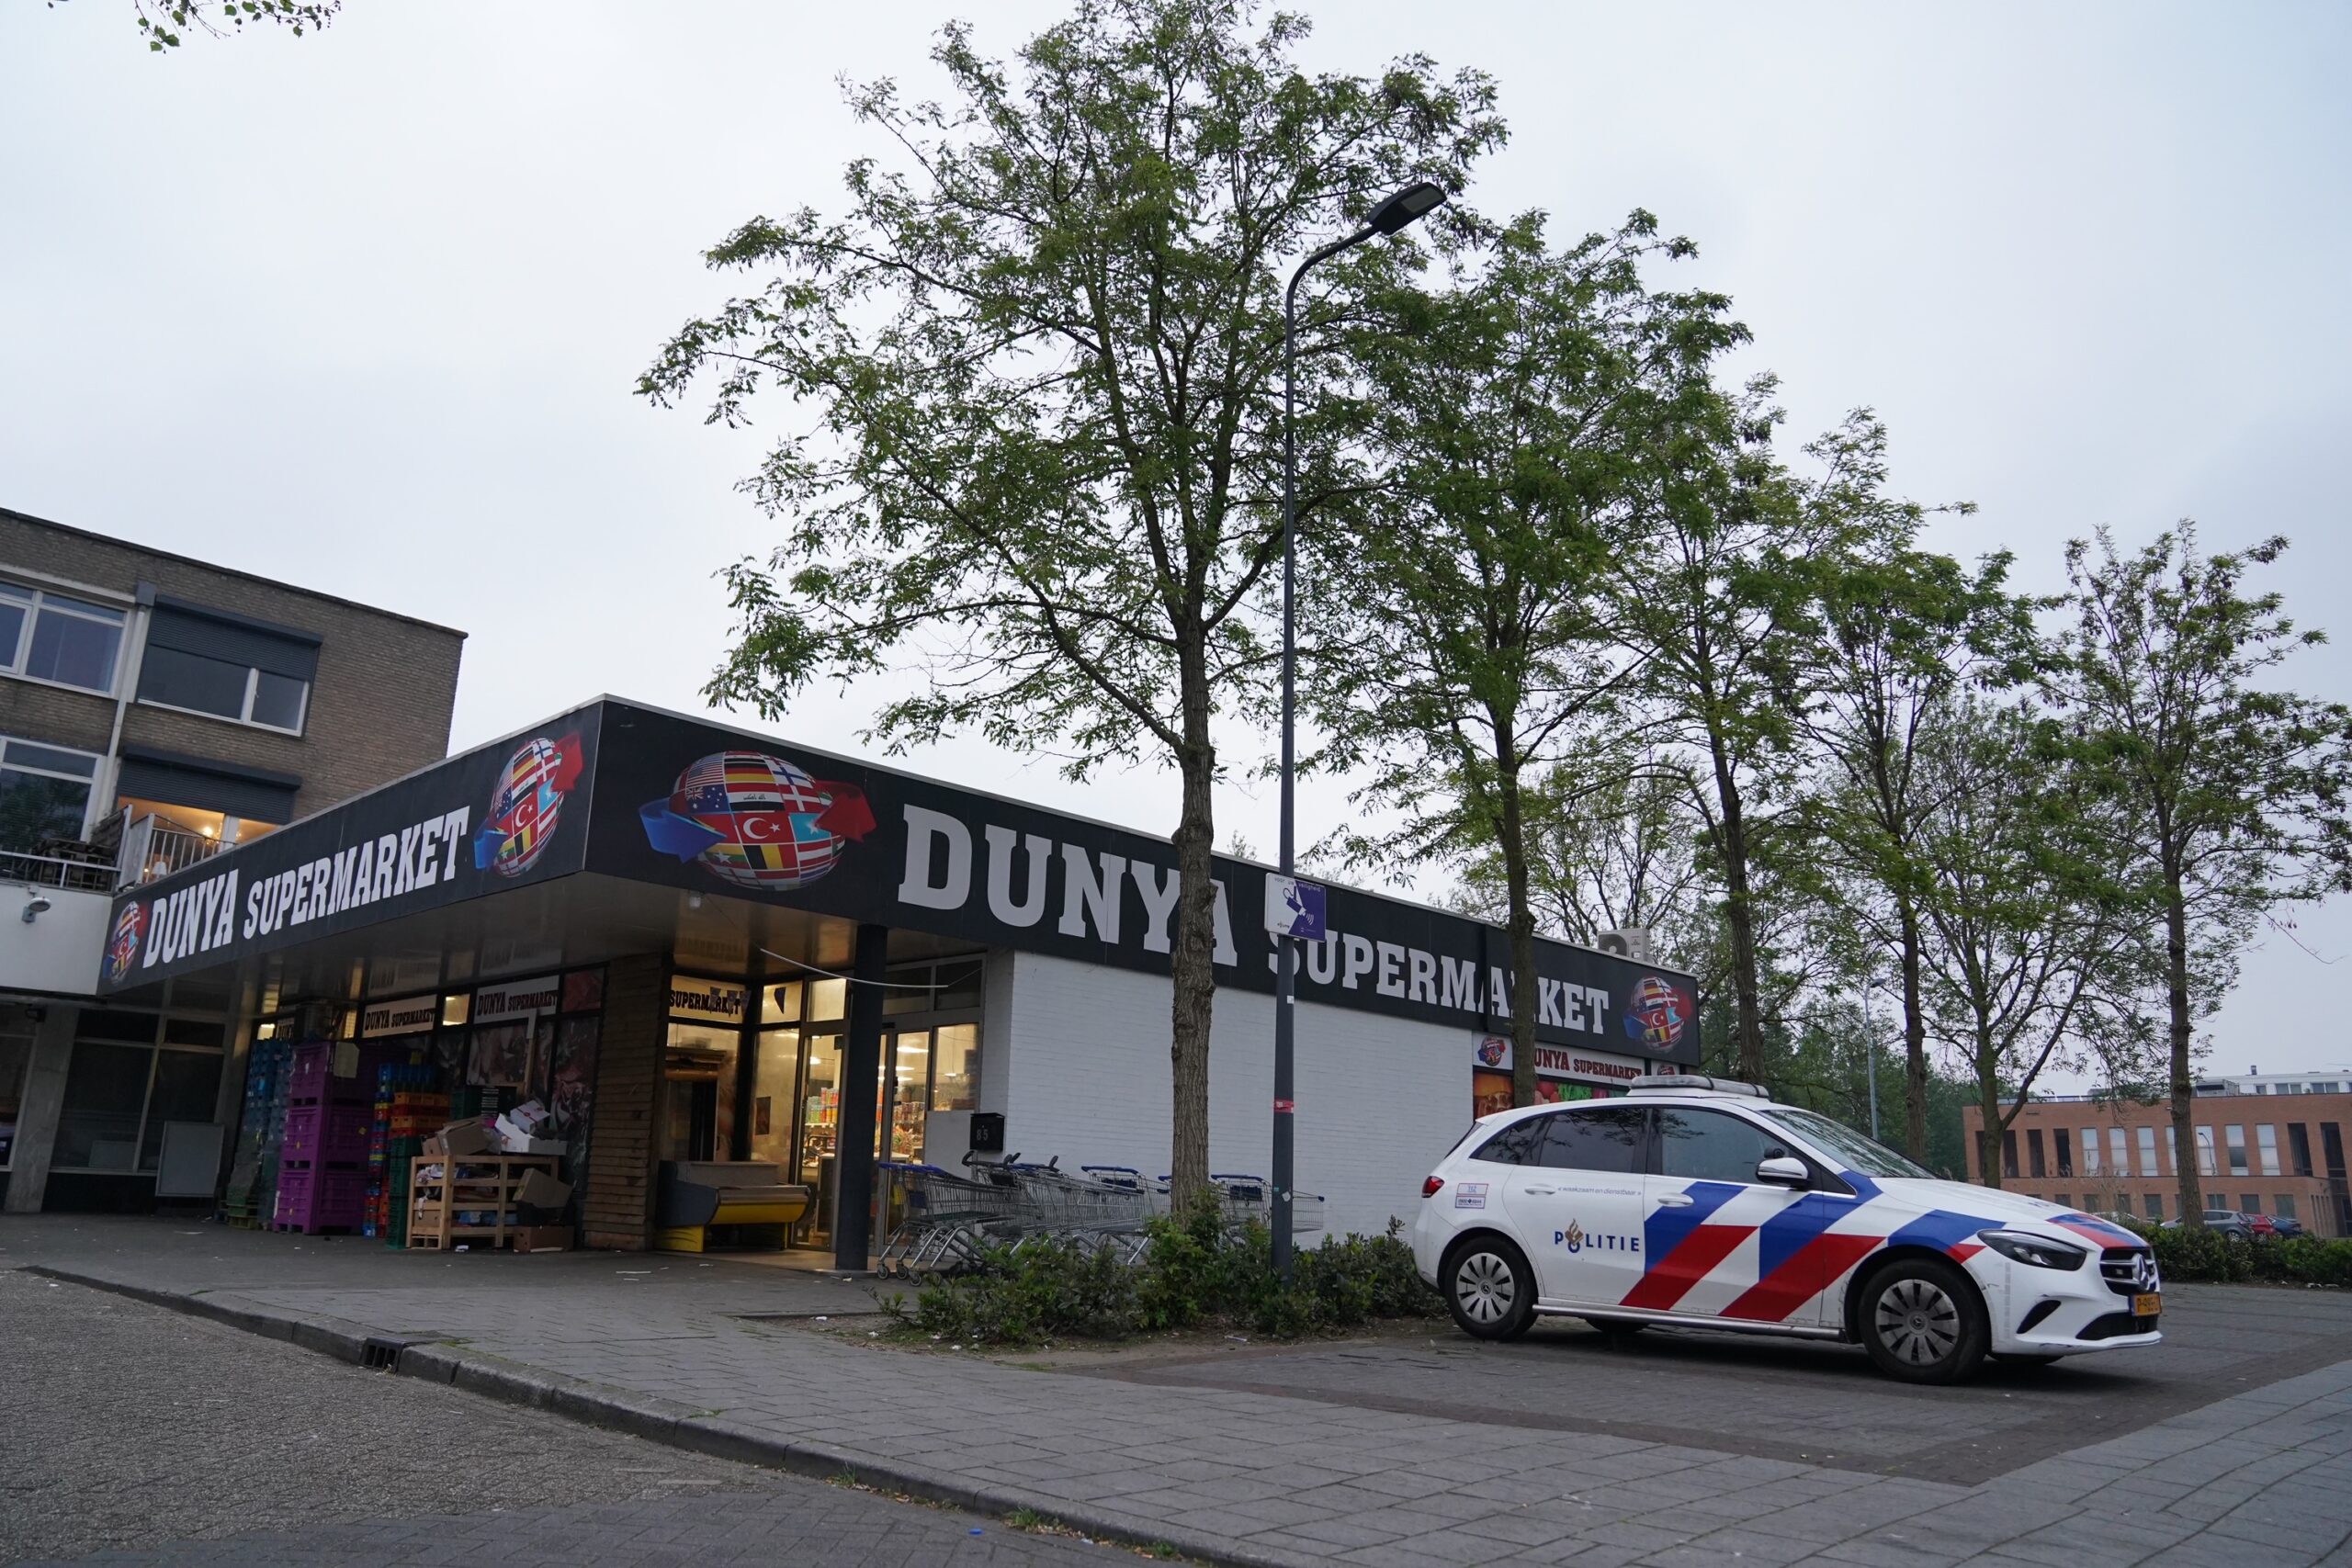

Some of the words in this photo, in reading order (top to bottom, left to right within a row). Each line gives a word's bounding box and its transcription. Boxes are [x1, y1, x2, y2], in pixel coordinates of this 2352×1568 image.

[142, 869, 239, 968] DUNYA
[243, 806, 470, 940] SUPERMARKET
[478, 992, 505, 1016] DUNYA
[508, 990, 559, 1011] SUPERMARKET
[365, 1010, 390, 1031] DUNYA
[391, 1009, 435, 1027] SUPERMARKET
[1534, 1048, 1570, 1071] UNYA
[976, 1129, 989, 1141] 85
[1555, 1231, 1639, 1253] POLITIE
